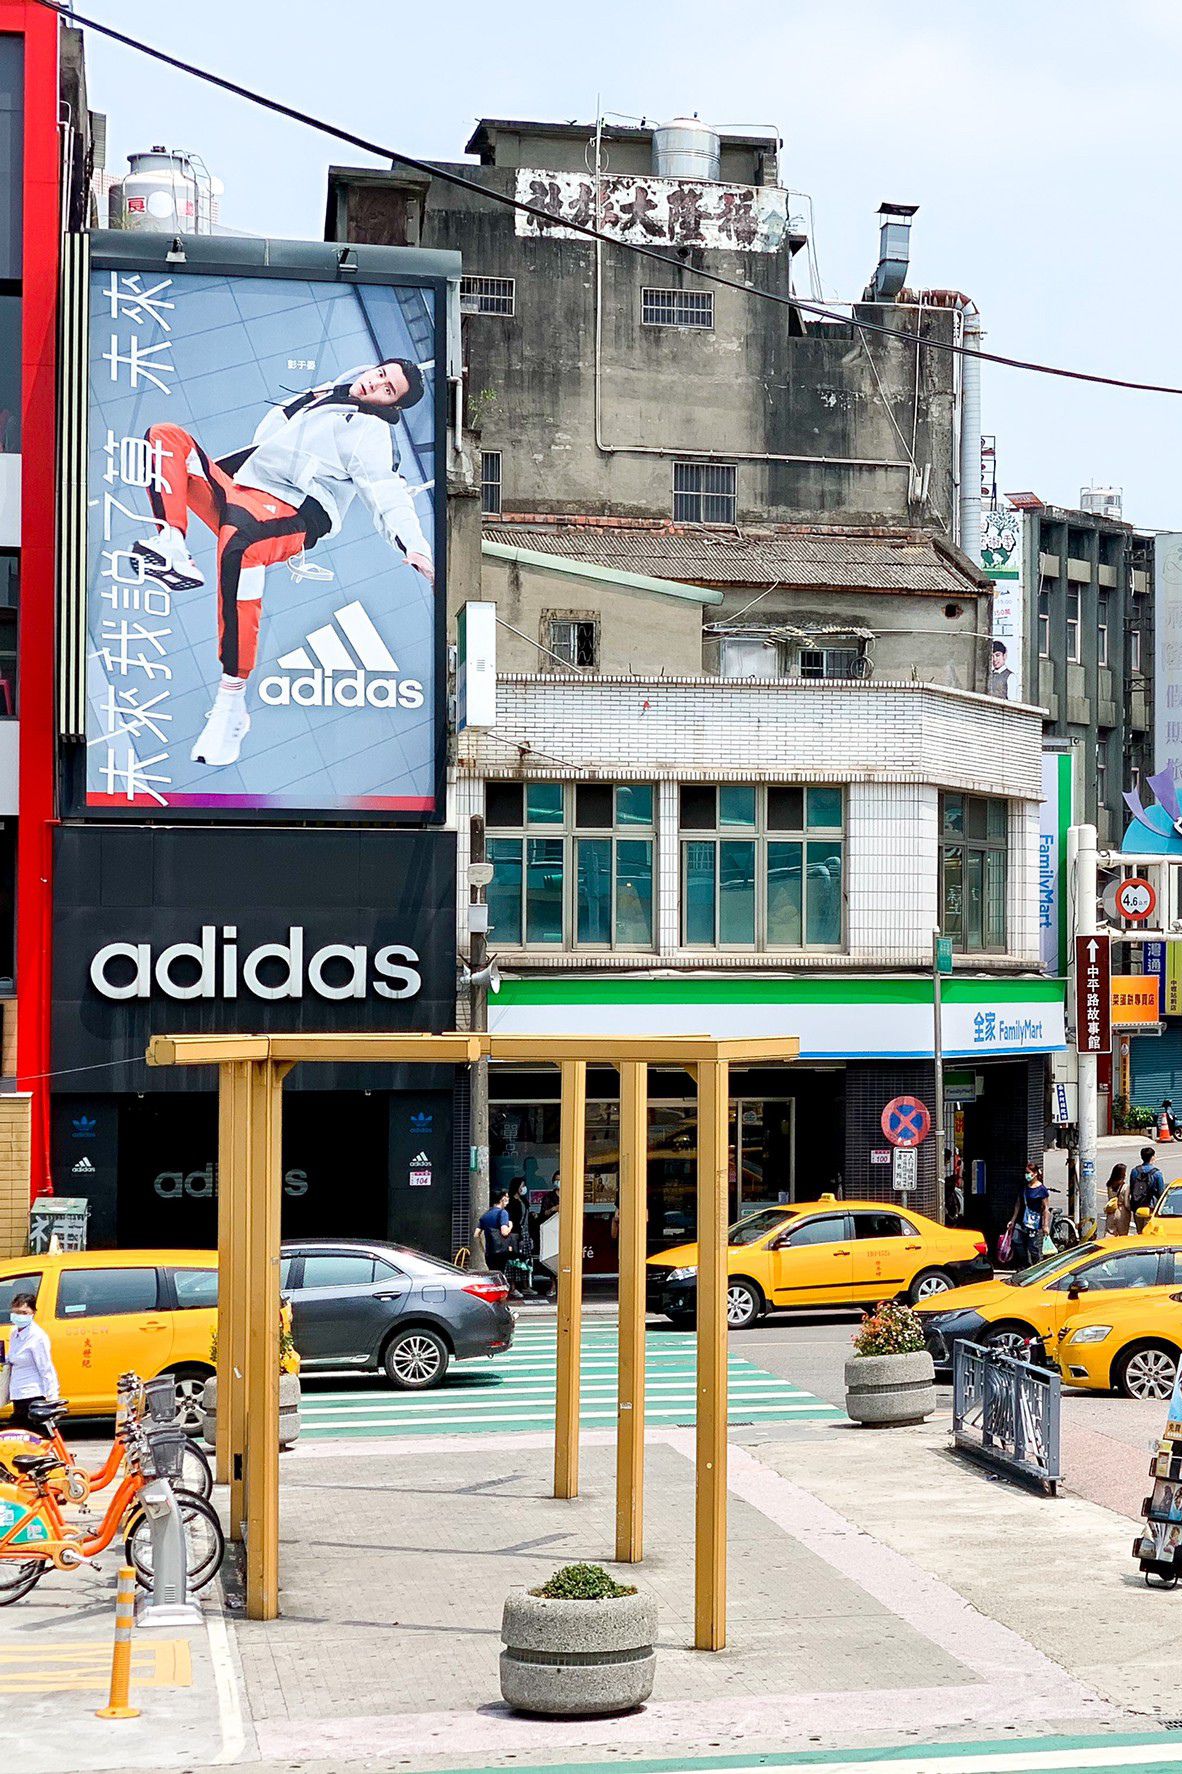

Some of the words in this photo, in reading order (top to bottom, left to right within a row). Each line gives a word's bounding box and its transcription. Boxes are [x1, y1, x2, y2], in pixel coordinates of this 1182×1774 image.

[258, 667, 426, 709] adidas
[1122, 893, 1138, 907] 4.6
[90, 925, 422, 1000] adidas
[1086, 965, 1102, 1050] 中平路故事館
[973, 1011, 996, 1043] 全家
[999, 1019, 1043, 1046] FamilyMart
[72, 1166, 96, 1174] adidas
[416, 1177, 428, 1185] 104
